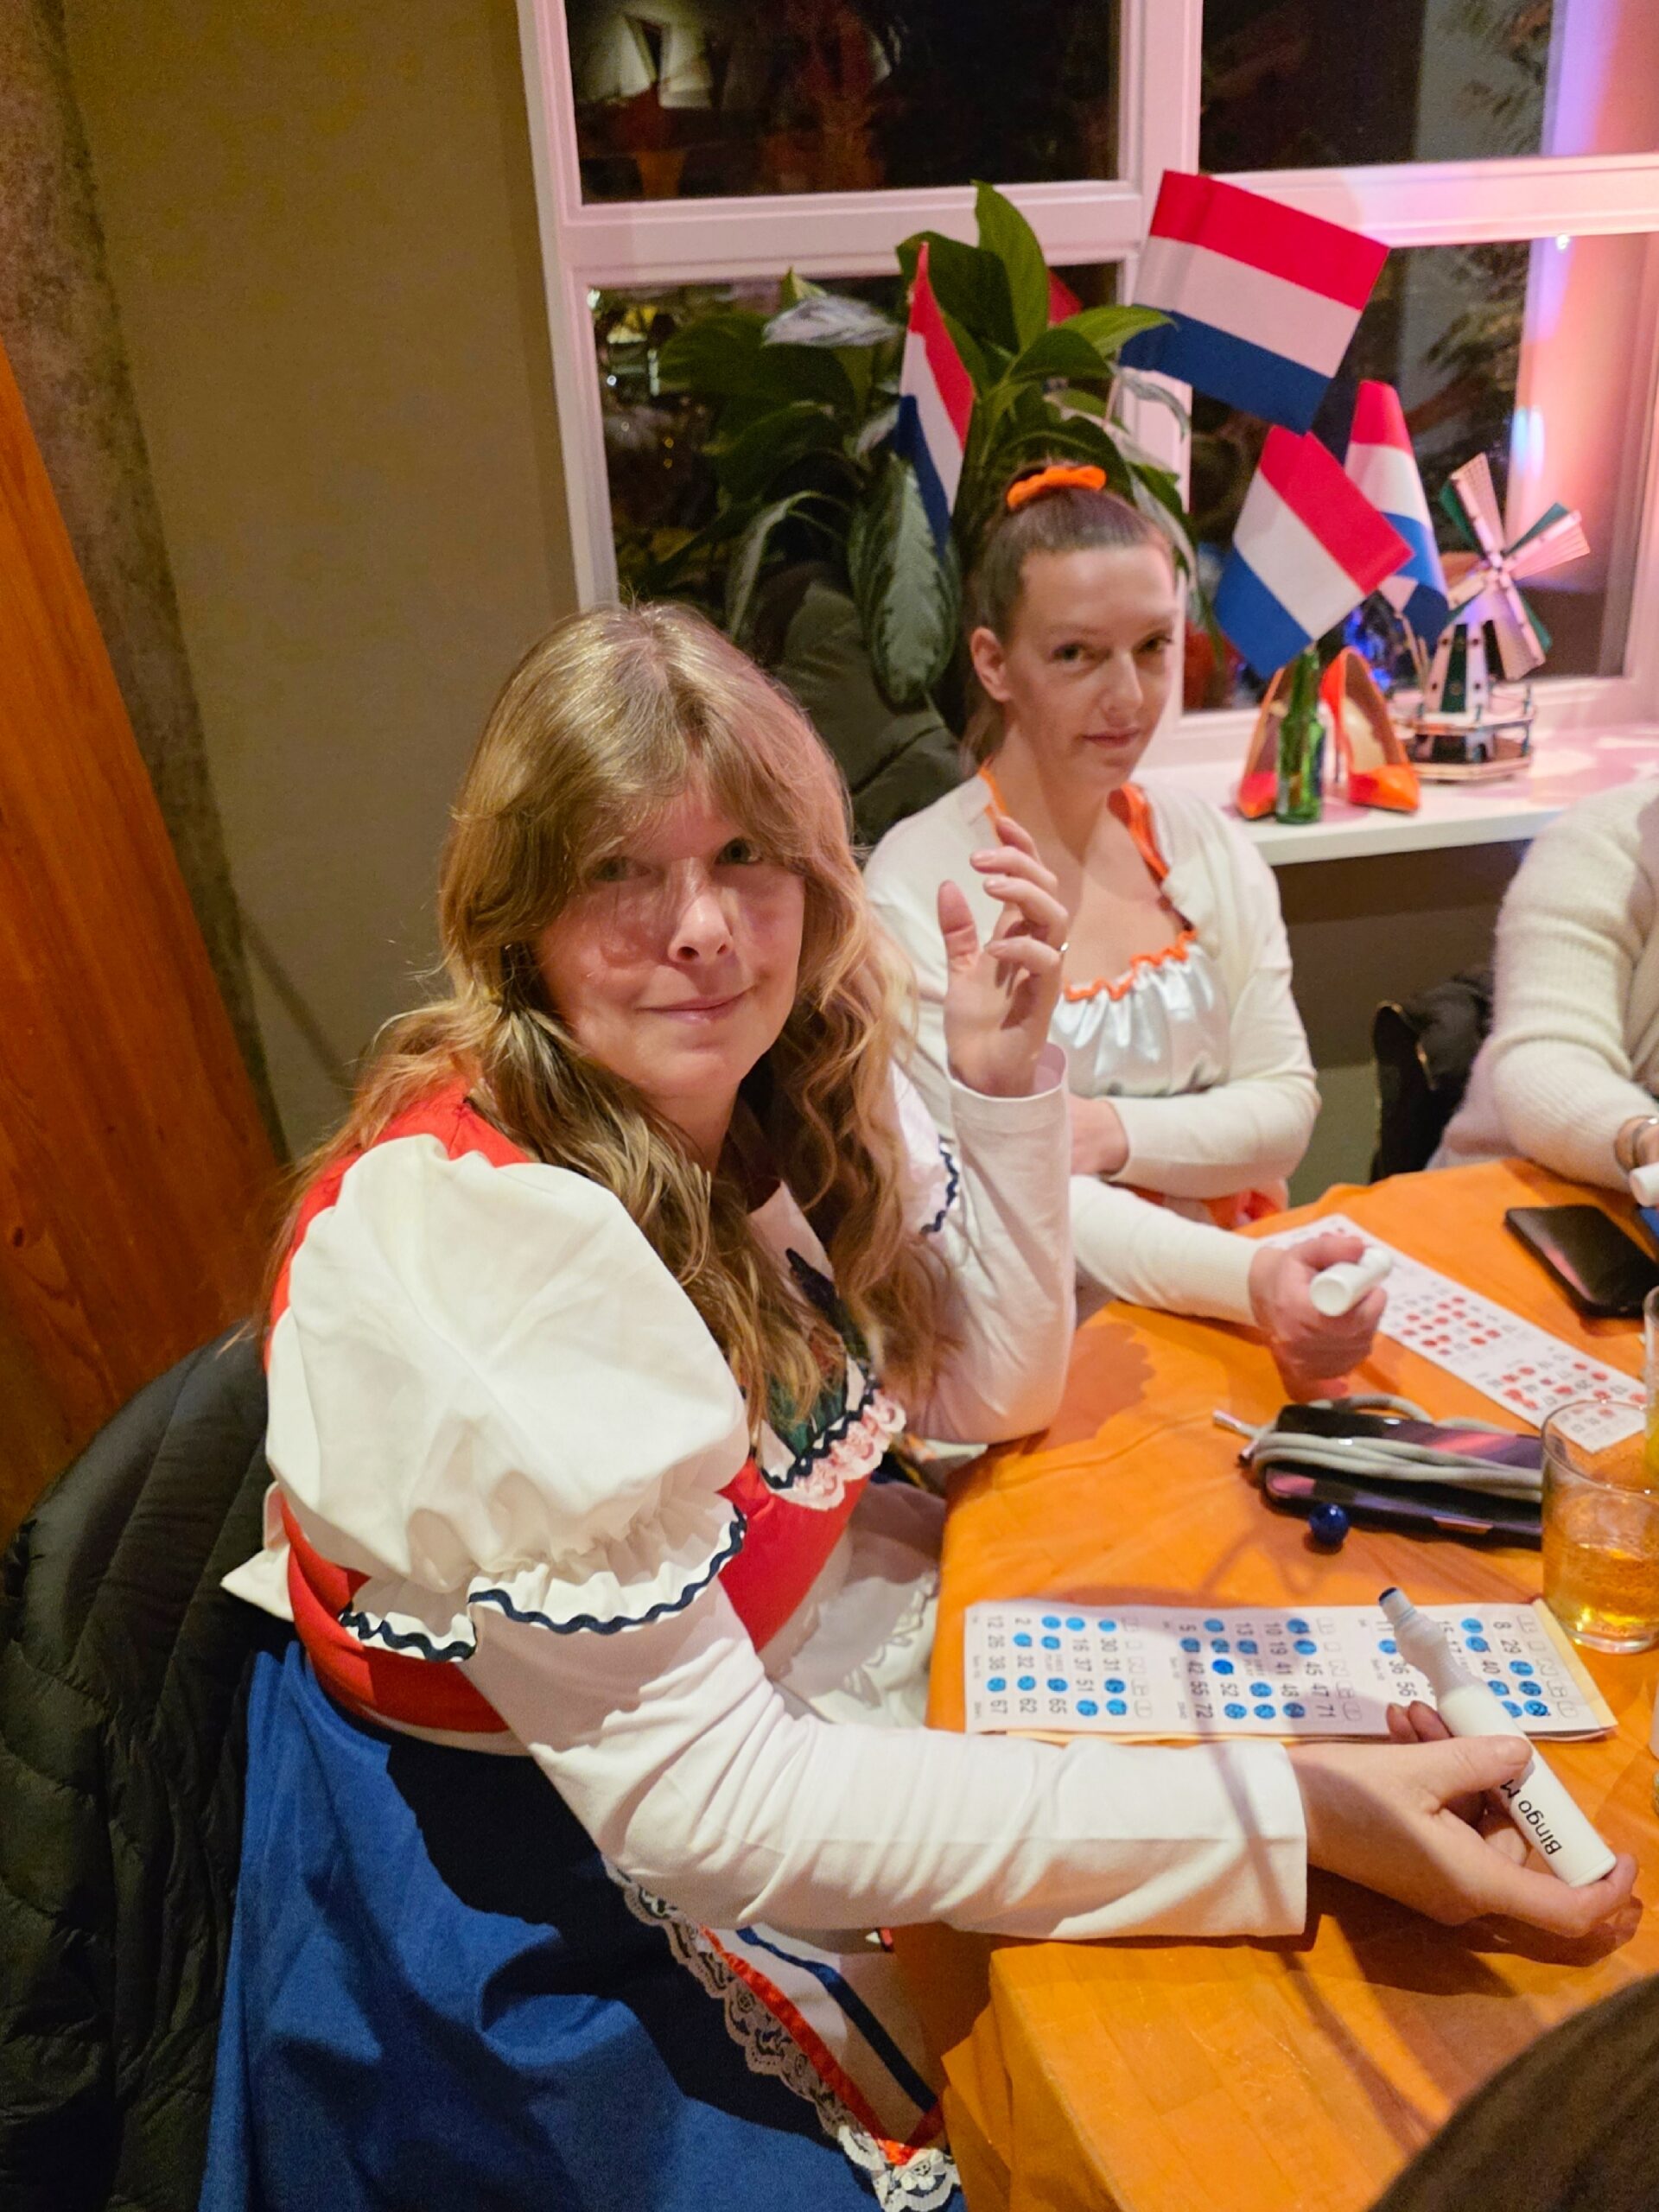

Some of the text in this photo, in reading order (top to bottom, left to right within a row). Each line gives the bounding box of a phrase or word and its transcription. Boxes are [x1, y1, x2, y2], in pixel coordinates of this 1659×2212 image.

[988, 1616, 1004, 1628] 12
[1236, 1623, 1253, 1635] 13
[1265, 1623, 1281, 1635] 10
[1270, 1641, 1287, 1656] 19
[1501, 1639, 1522, 1653] 29
[1101, 1638, 1120, 1671] 30 31
[1377, 1621, 1418, 1696] 11 36 56
[1018, 1656, 1033, 1669] 32
[1075, 1657, 1091, 1671] 37
[1188, 1660, 1205, 1674] 42
[1276, 1662, 1293, 1675] 41
[1482, 1660, 1502, 1674] 40
[1077, 1679, 1095, 1692] 51
[1192, 1681, 1209, 1695] 55
[1222, 1683, 1238, 1697] 52
[1281, 1683, 1300, 1697] 48
[1306, 1662, 1334, 1718] 45 47 71
[990, 1700, 1007, 1713] 67
[1020, 1699, 1037, 1713] 62
[1049, 1699, 1067, 1714] 65
[1196, 1703, 1213, 1718] 72
[1501, 1779, 1562, 1855] Bingo M
